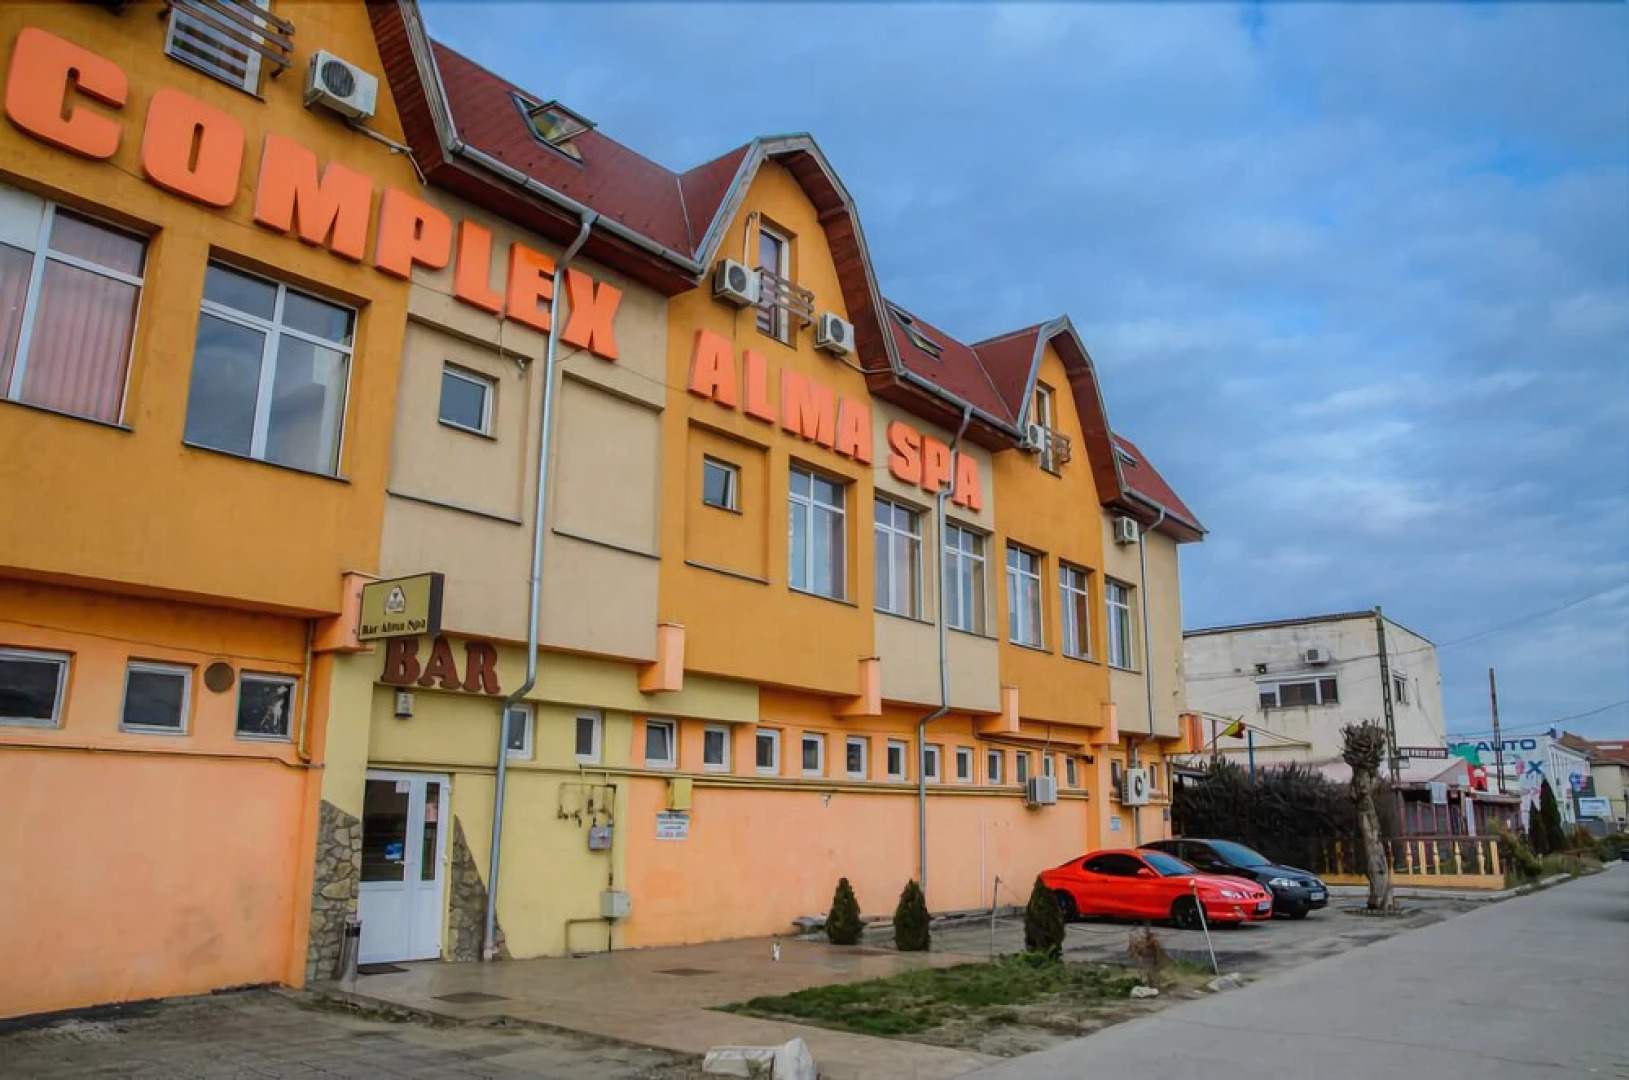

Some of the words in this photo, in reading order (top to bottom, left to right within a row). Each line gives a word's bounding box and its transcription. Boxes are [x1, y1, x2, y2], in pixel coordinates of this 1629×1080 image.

[6, 27, 622, 360] COMPLEX
[687, 329, 871, 466] ALMA
[887, 420, 983, 513] SPA
[381, 634, 501, 694] BAR
